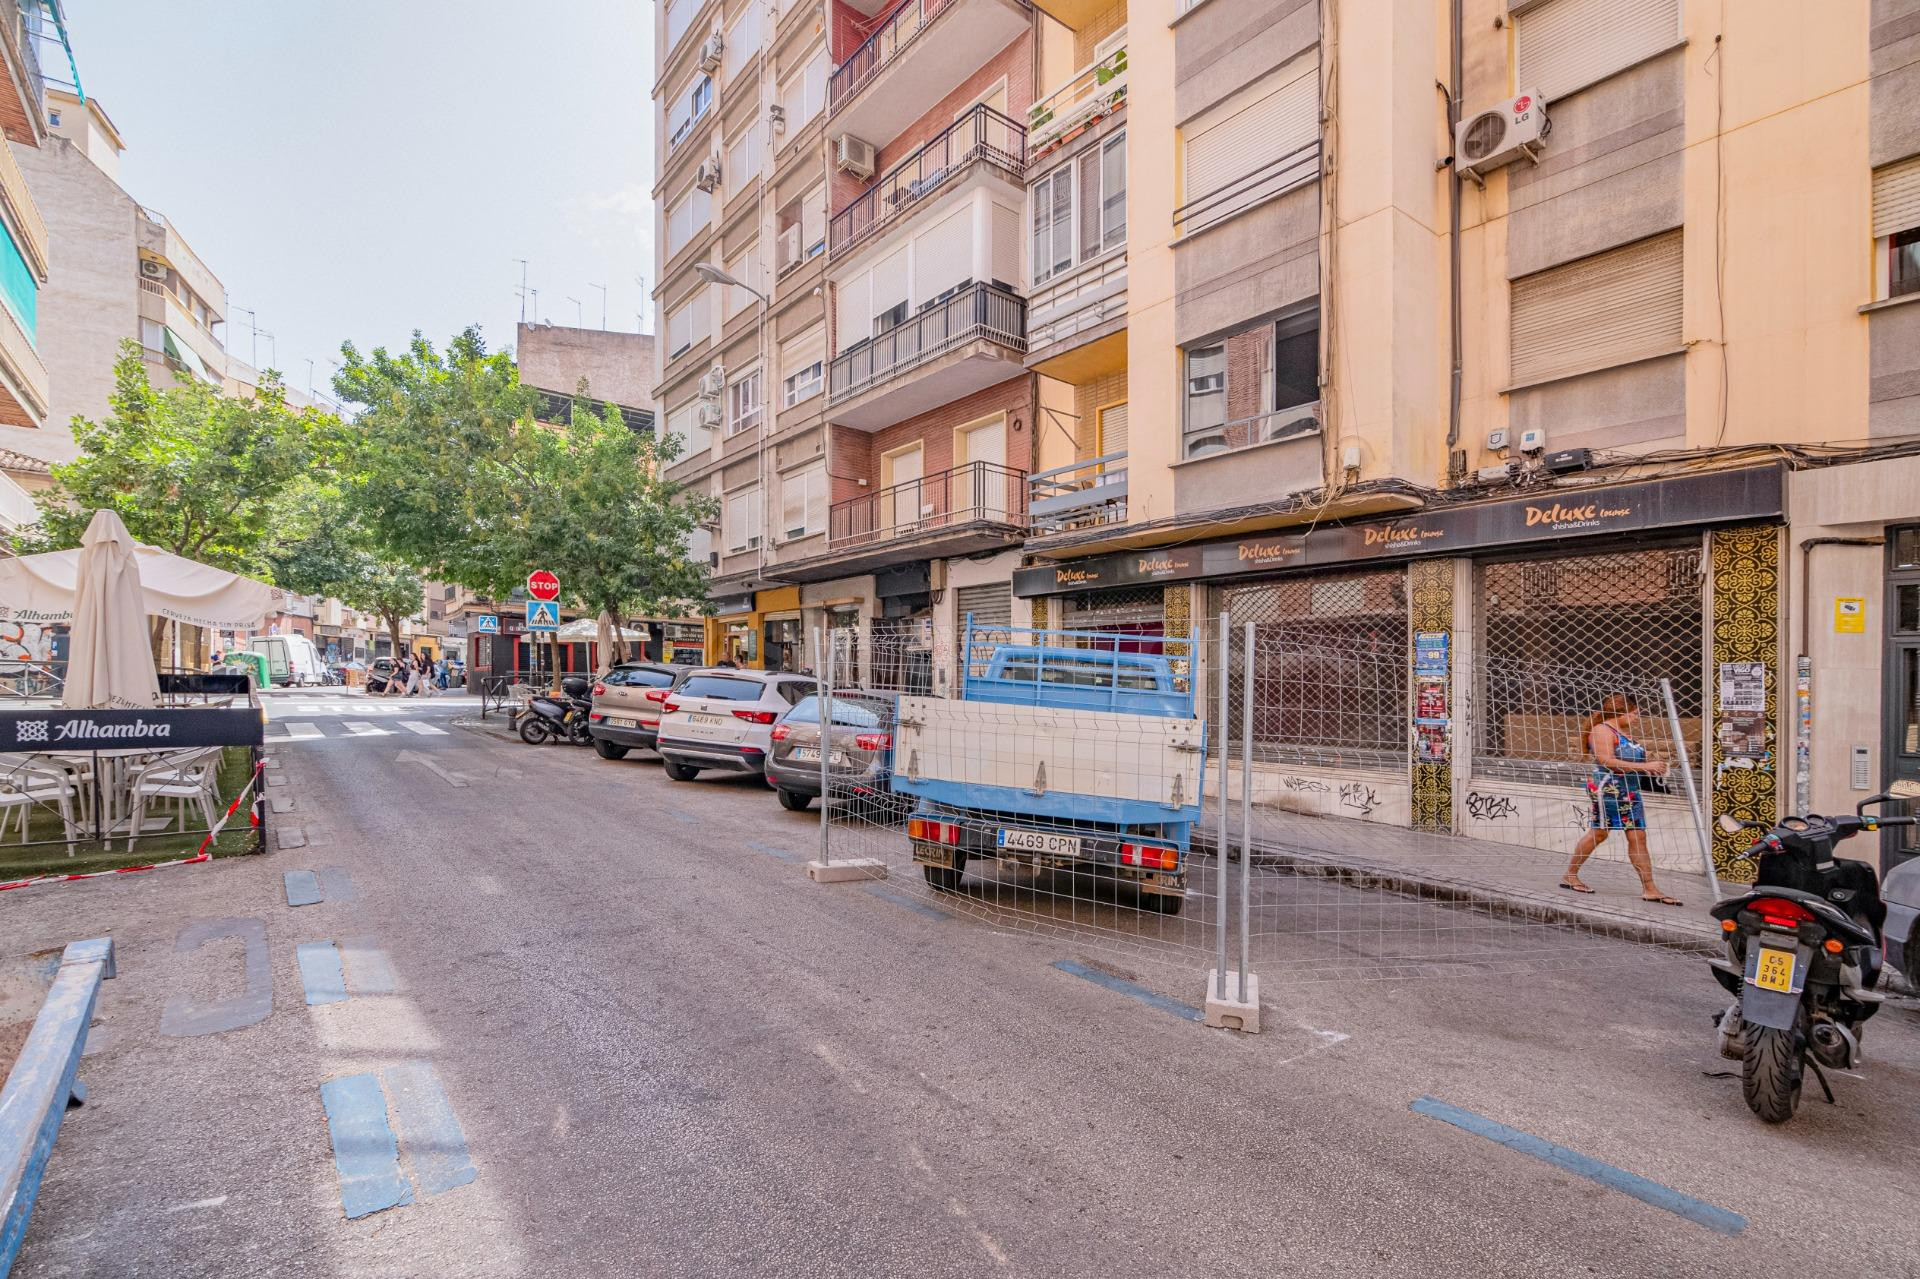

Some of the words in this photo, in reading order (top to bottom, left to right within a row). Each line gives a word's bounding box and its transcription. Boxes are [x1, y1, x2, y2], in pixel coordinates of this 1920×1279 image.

[1514, 112, 1530, 125] LG
[1525, 503, 1597, 527] Deluxe
[1364, 525, 1418, 546] Deluxe
[1238, 543, 1281, 561] Deluxe
[1138, 556, 1173, 573] Deluxe
[530, 581, 558, 591] STOP
[54, 719, 171, 741] Alhambra
[1007, 831, 1044, 849] 4469
[1049, 836, 1077, 854] CPN
[1763, 964, 1786, 977] 364
